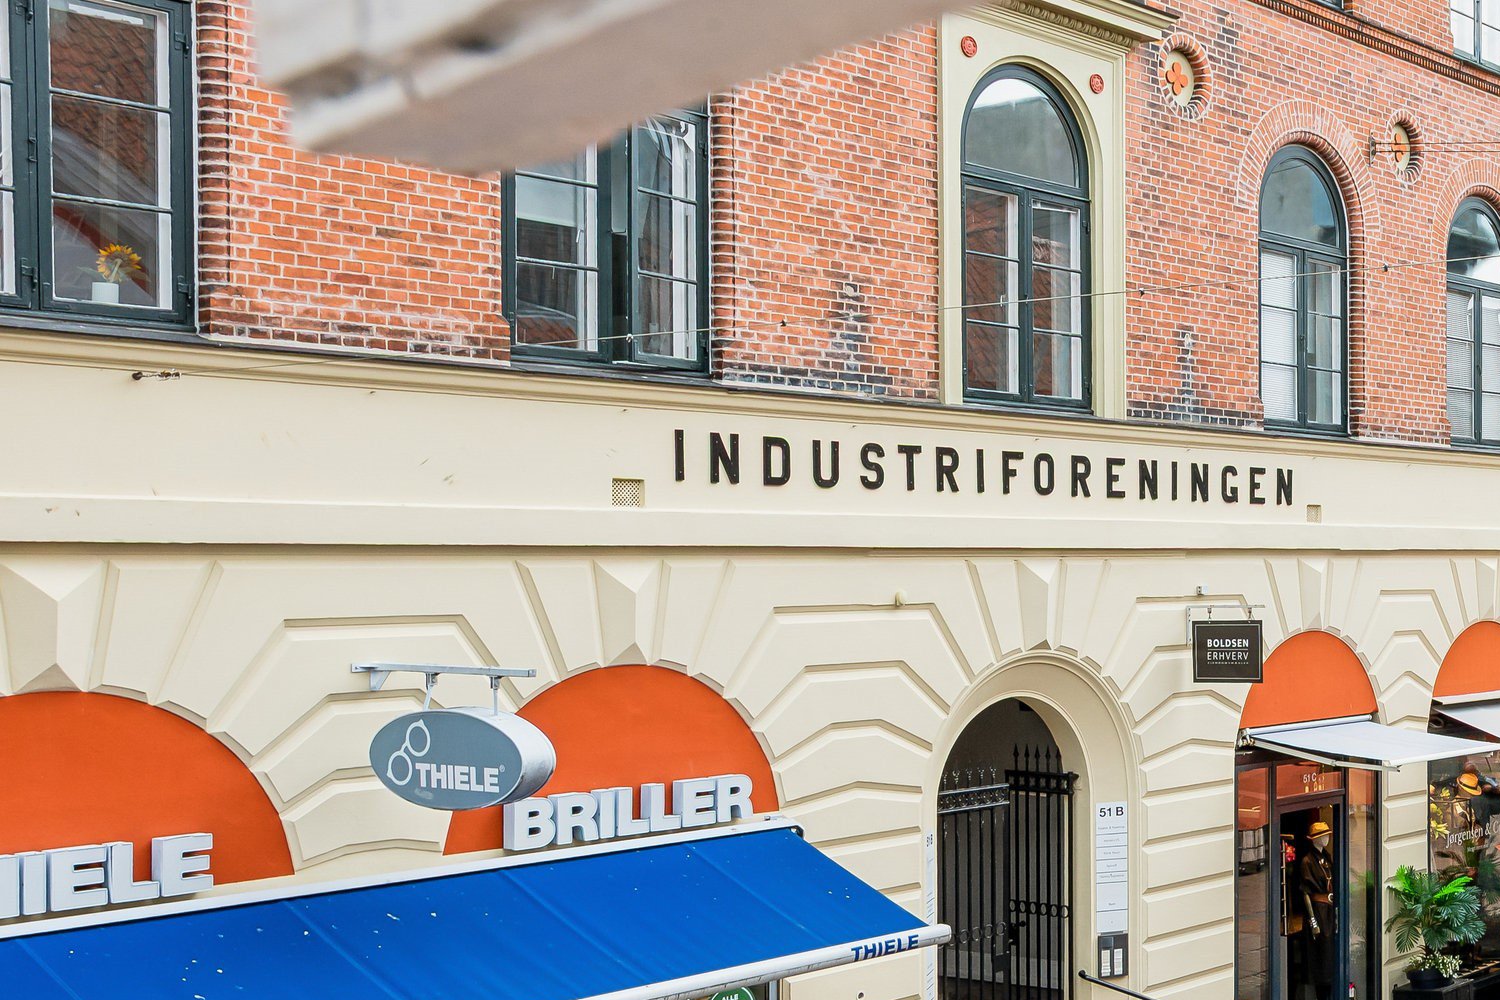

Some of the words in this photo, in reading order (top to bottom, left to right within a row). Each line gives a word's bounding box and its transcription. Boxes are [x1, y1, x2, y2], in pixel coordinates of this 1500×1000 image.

[674, 429, 1293, 506] INDUSTRIFORENINGEN
[1207, 639, 1249, 648] BOLDSEN
[1207, 651, 1249, 661] ERHVERV
[504, 773, 755, 851] BRILLER
[1099, 807, 1112, 817] 51
[1115, 806, 1124, 816] B
[1446, 825, 1484, 848] Jørgensen
[0, 833, 213, 919] IELE
[851, 934, 919, 962] THIELE
